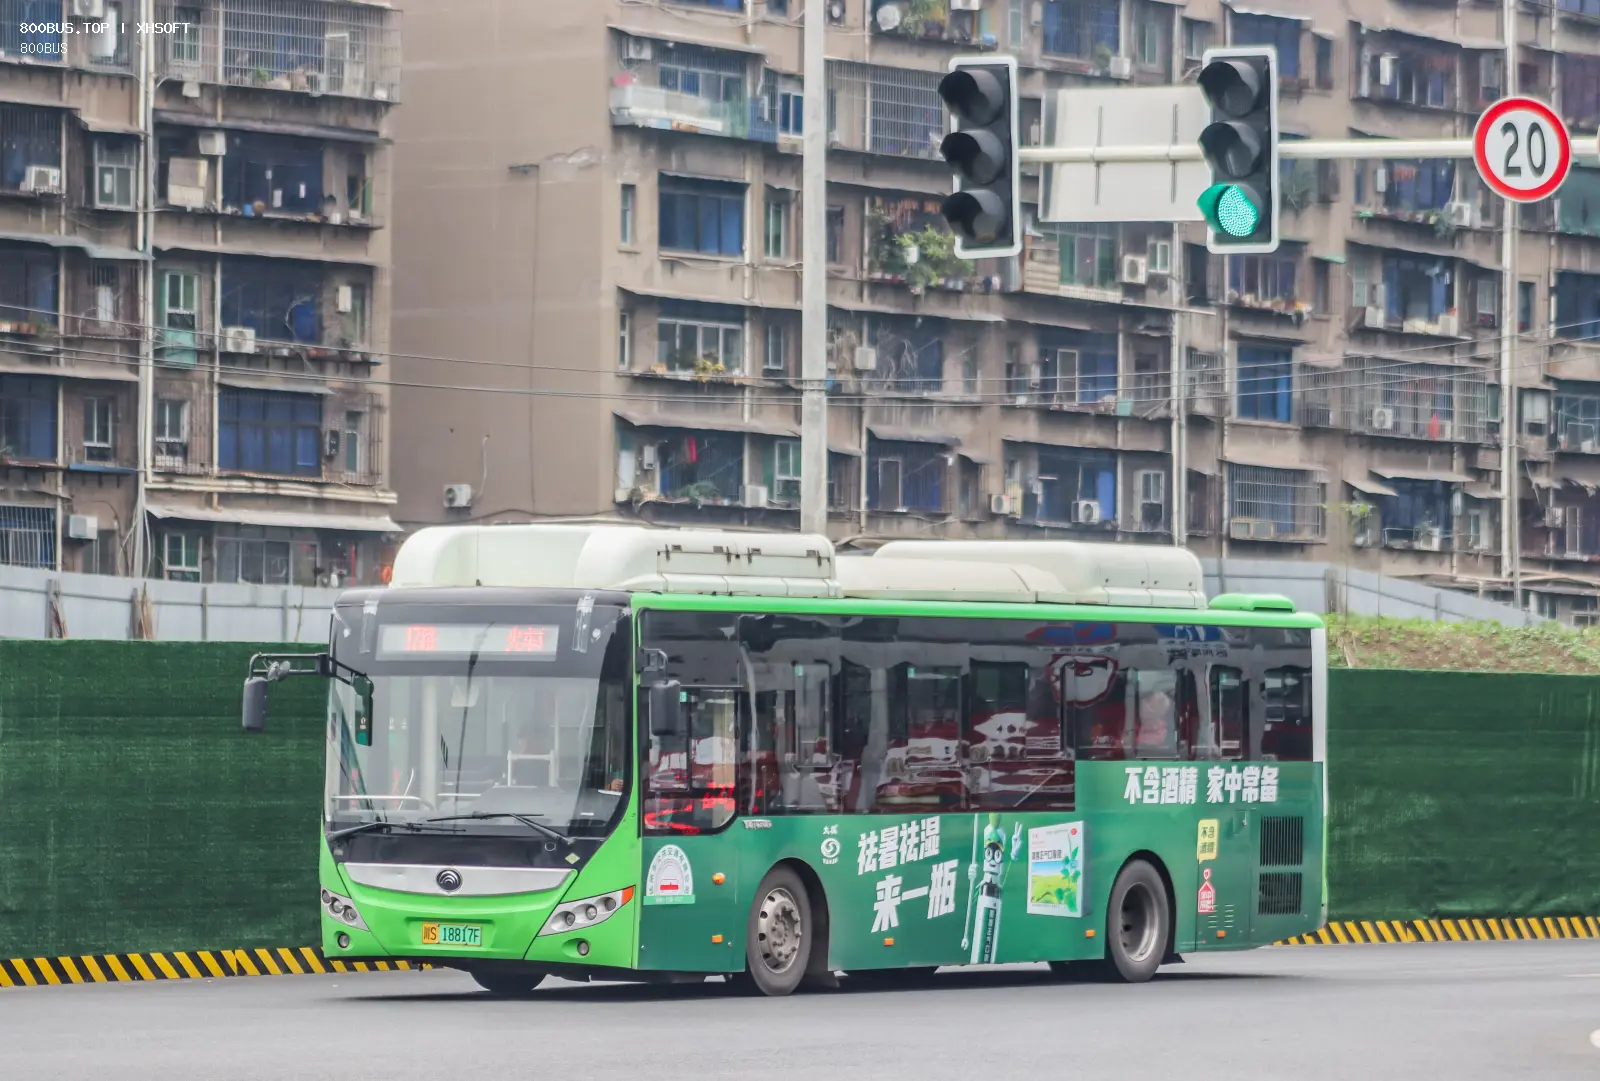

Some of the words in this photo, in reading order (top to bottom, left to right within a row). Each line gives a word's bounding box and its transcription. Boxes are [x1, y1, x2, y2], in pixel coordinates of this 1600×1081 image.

[1500, 121, 1547, 178] 20
[1123, 765, 1199, 804] 不含酒精
[1206, 765, 1280, 803] 家中常备
[857, 815, 941, 876] 祛暑祛湿
[870, 859, 959, 934] 来一瓶
[442, 926, 480, 943] 18817F
